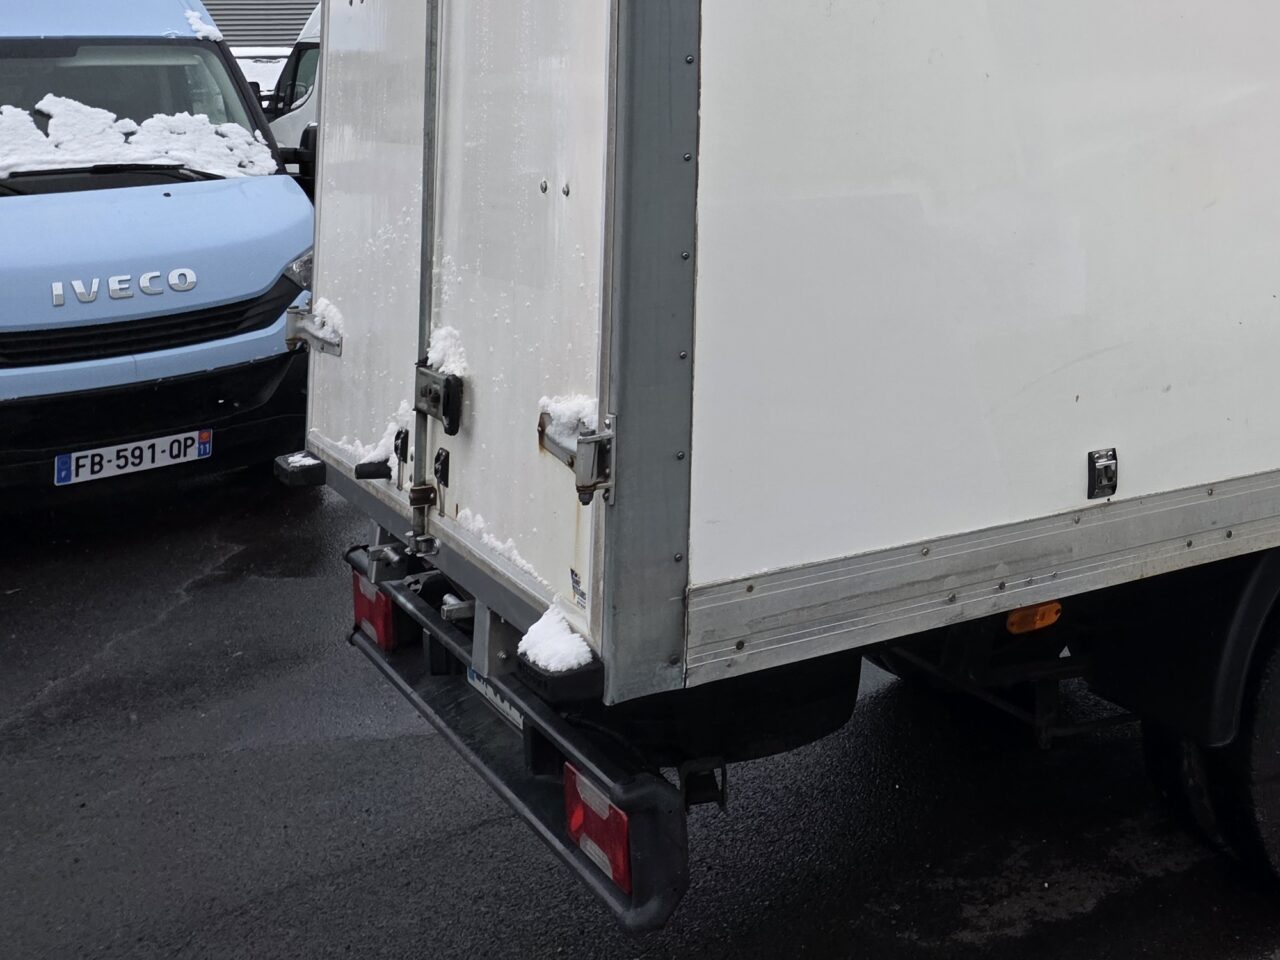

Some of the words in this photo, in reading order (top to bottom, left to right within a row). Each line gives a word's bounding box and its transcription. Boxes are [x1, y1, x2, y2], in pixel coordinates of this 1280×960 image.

[51, 267, 198, 307] IVECO
[75, 436, 196, 478] FB-591-QP
[199, 443, 210, 457] 11
